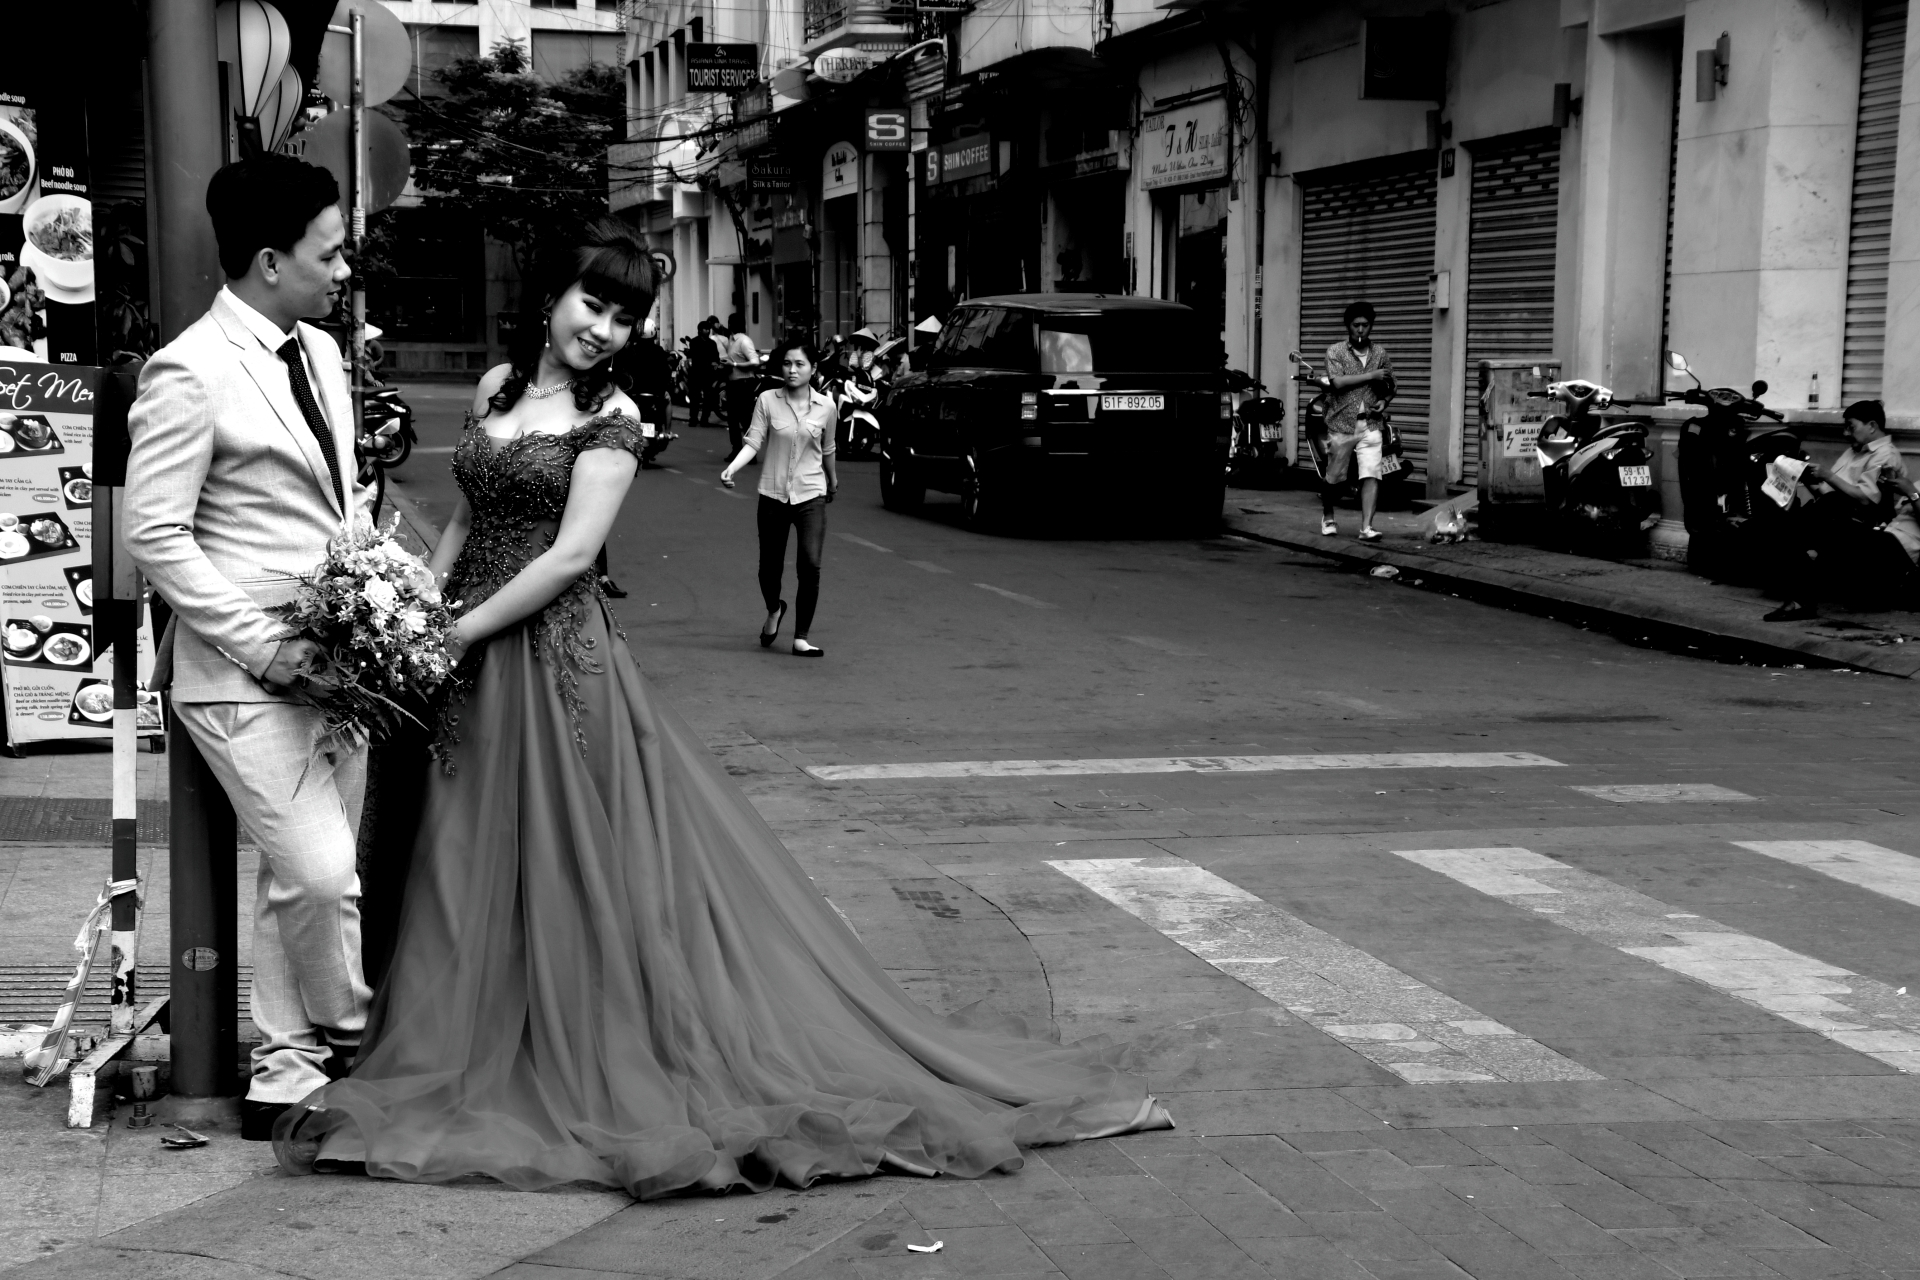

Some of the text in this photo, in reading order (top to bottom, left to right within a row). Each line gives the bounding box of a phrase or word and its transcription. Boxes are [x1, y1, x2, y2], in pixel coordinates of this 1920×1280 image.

[690, 68, 720, 86] TOURIST
[11, 95, 26, 104] soup
[868, 114, 904, 140] S
[1145, 116, 1164, 133] TAILOR
[944, 144, 988, 171] SHIN COFFEE
[752, 163, 791, 175] Sakura
[41, 179, 87, 193] Beef noodle soup
[2, 252, 14, 262] rolls
[60, 352, 77, 362] PIZZA
